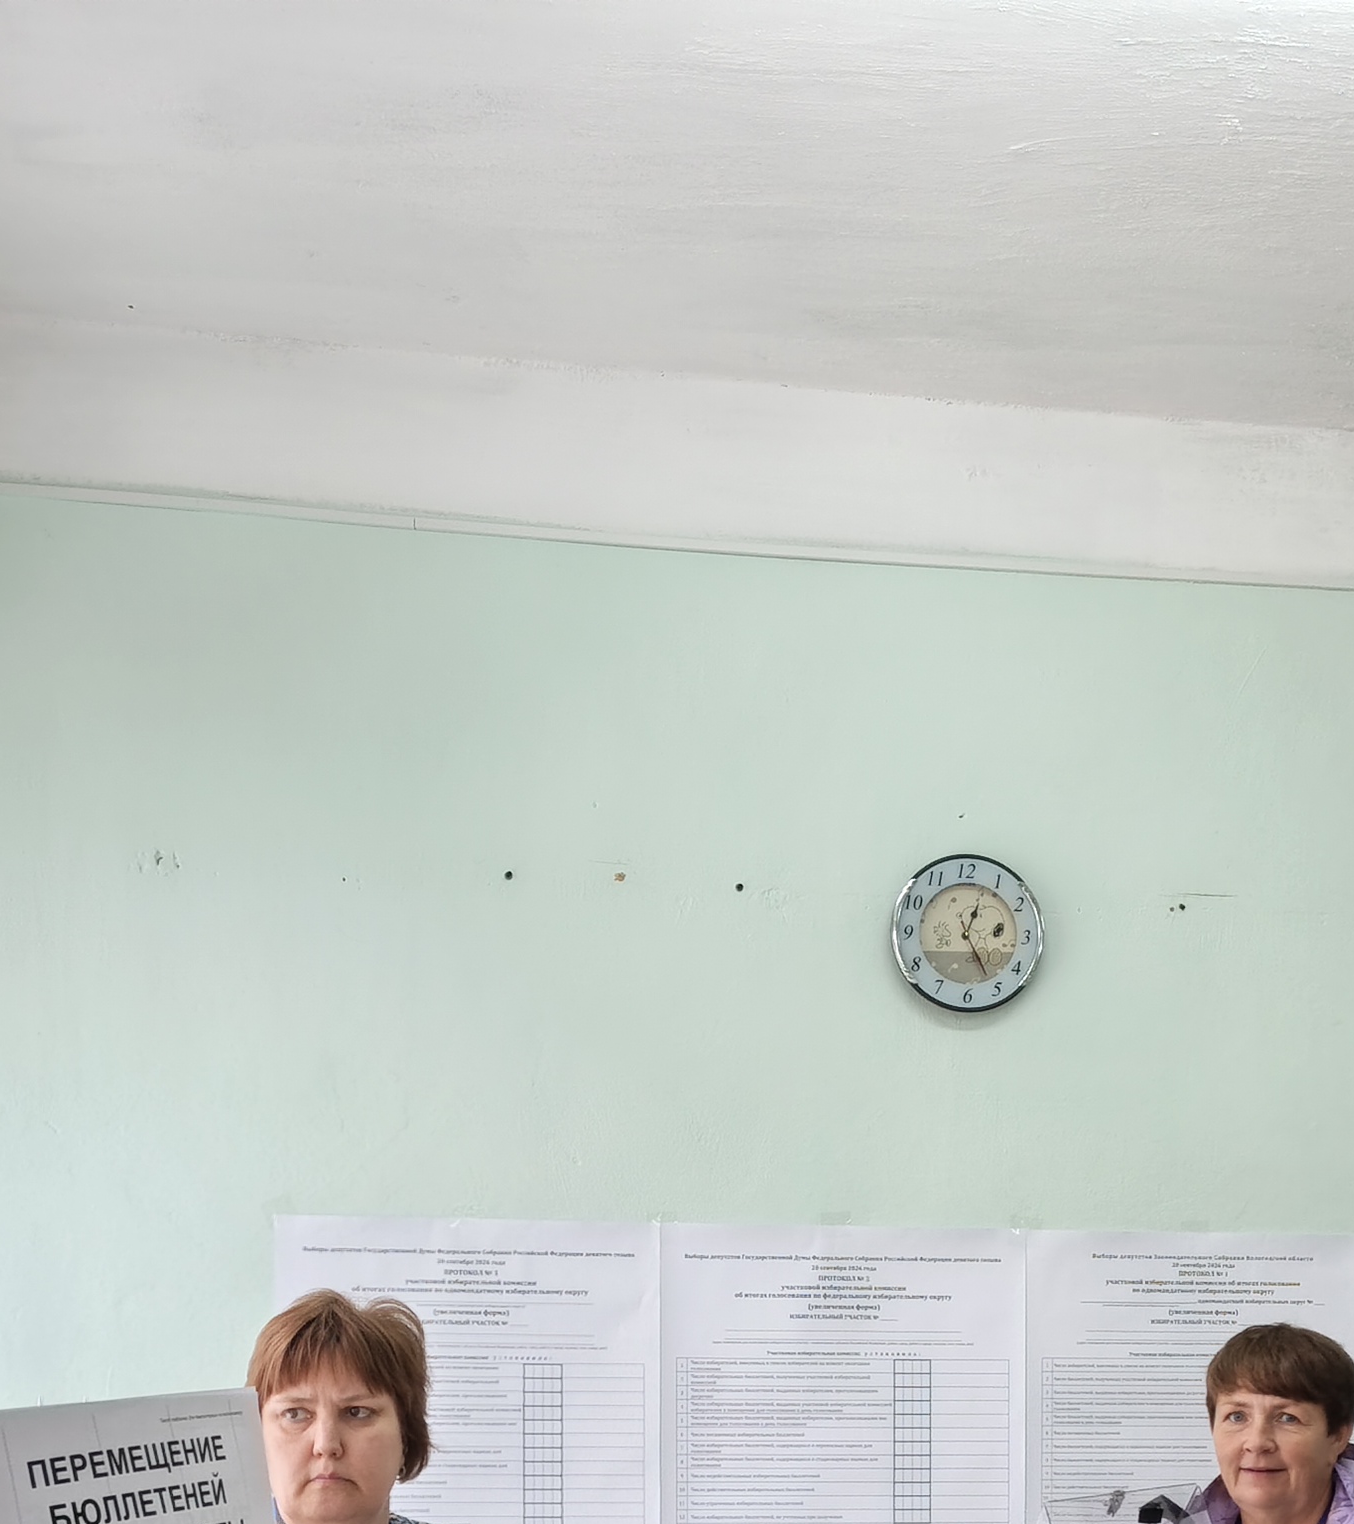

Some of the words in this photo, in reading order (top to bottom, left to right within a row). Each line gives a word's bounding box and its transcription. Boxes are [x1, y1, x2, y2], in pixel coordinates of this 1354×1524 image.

[928, 871, 943, 887] 11
[957, 863, 976, 880] 12
[995, 873, 1002, 889] 1
[904, 894, 923, 911] 10
[1013, 896, 1024, 912] 2
[903, 924, 914, 941] 9
[1020, 929, 1031, 946] 3
[910, 956, 922, 973] 8
[1010, 960, 1021, 976] 4
[934, 979, 944, 995] 7
[962, 987, 973, 1004] 6
[991, 981, 1002, 997] 5
[26, 1434, 227, 1489] ПЕРЕМЕЩЕНИЕ
